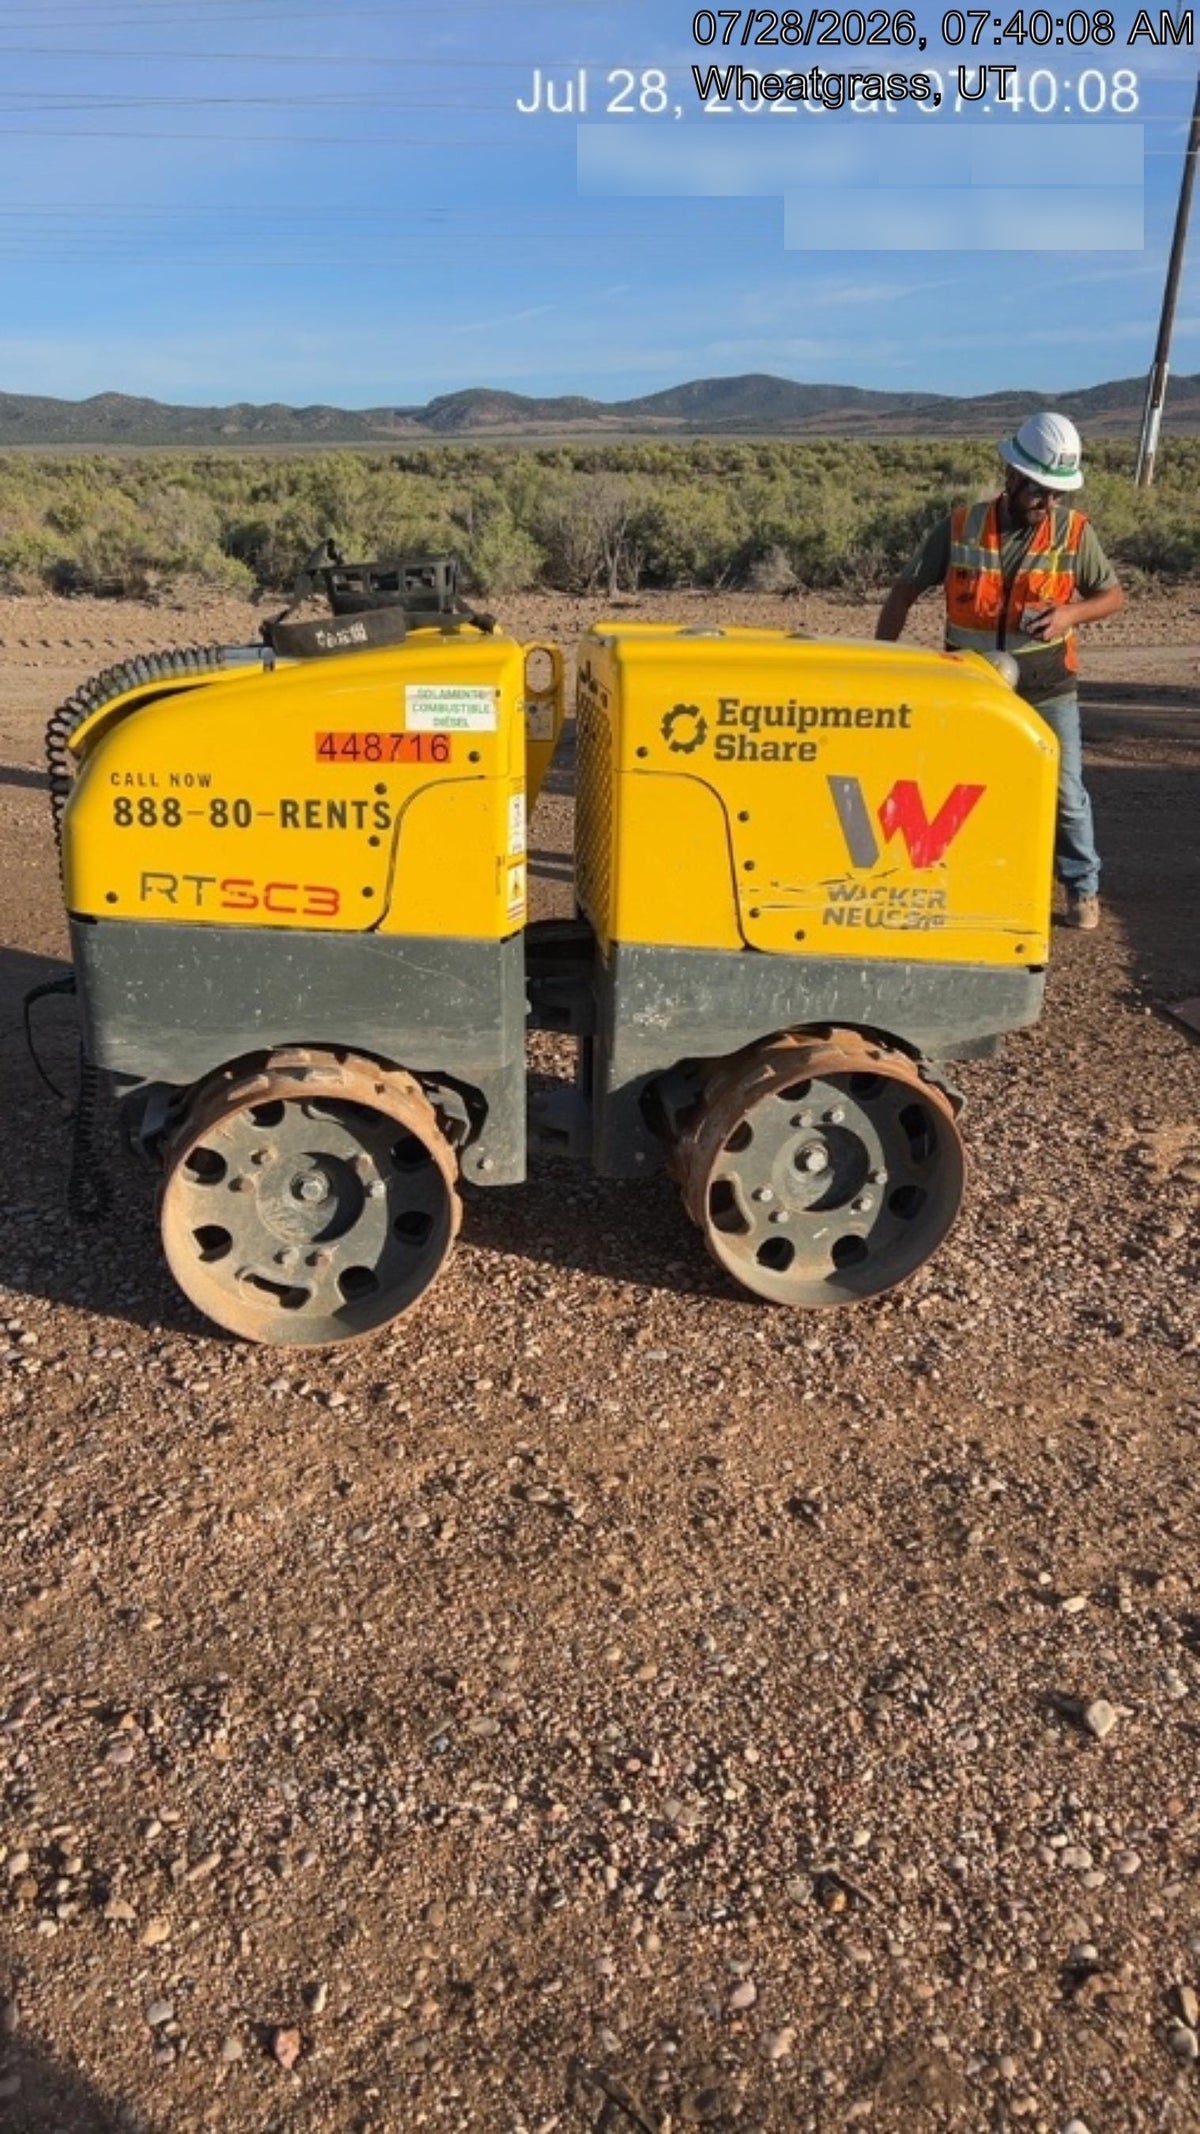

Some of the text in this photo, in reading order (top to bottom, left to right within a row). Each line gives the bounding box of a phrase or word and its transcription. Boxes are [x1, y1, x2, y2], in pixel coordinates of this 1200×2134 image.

[716, 698, 912, 733] Equipment
[318, 732, 449, 762] 448716
[714, 734, 818, 762] Share
[110, 772, 213, 788] CALL NOW
[113, 796, 392, 830] 888-80-RENTS
[827, 884, 947, 910] WACKER
